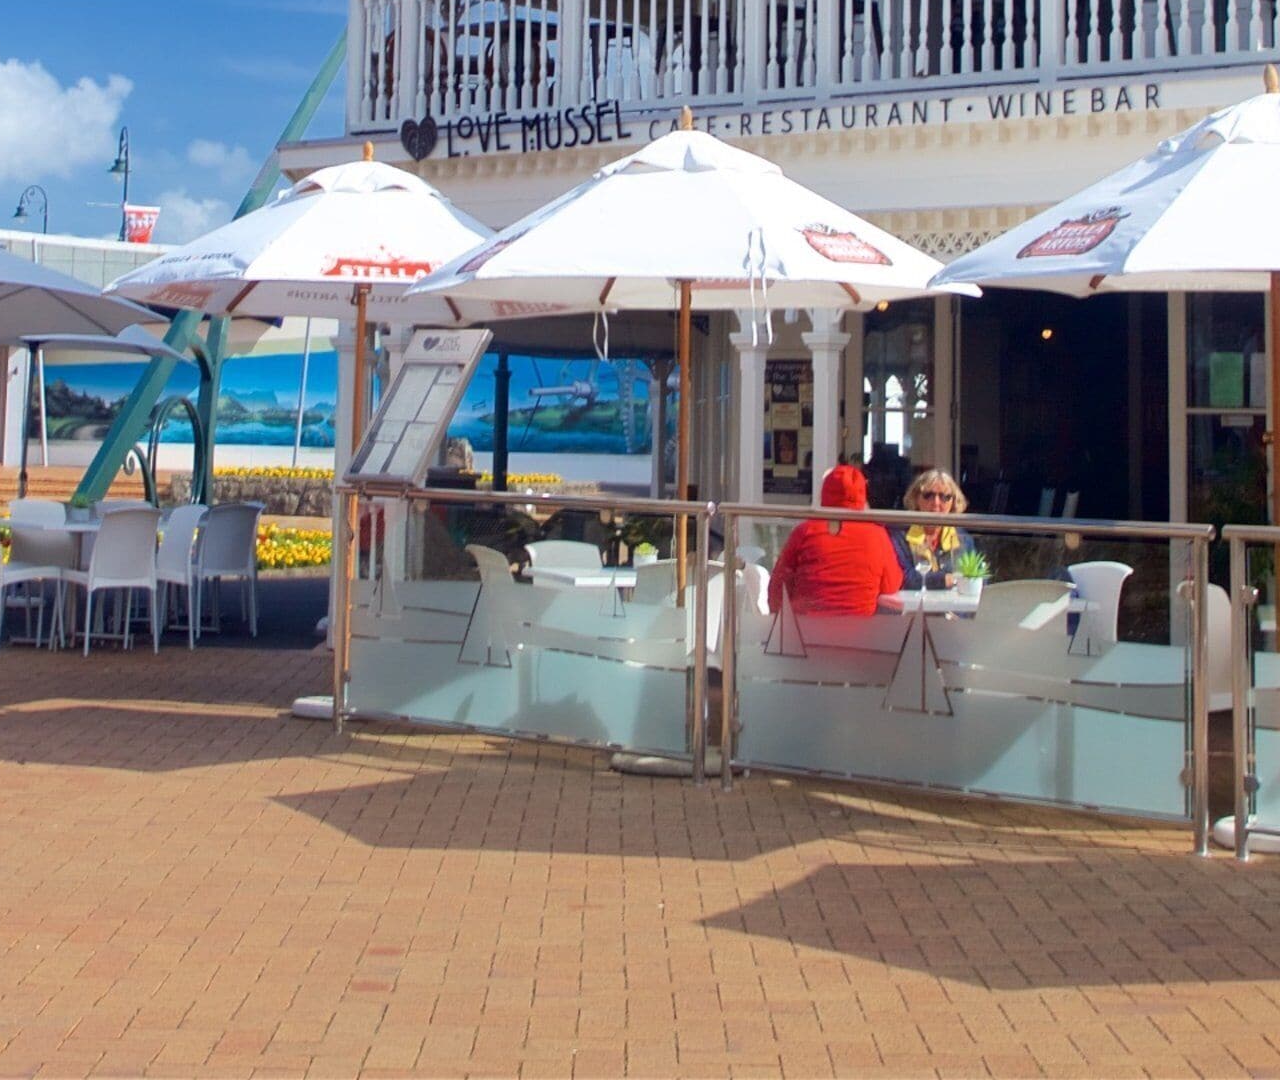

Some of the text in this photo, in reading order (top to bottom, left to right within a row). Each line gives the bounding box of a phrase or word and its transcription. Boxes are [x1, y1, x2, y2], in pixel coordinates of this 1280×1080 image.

[447, 100, 631, 158] LOVE MUSSEL
[740, 97, 953, 136] RESTAURANT
[339, 264, 427, 279] STELLA
